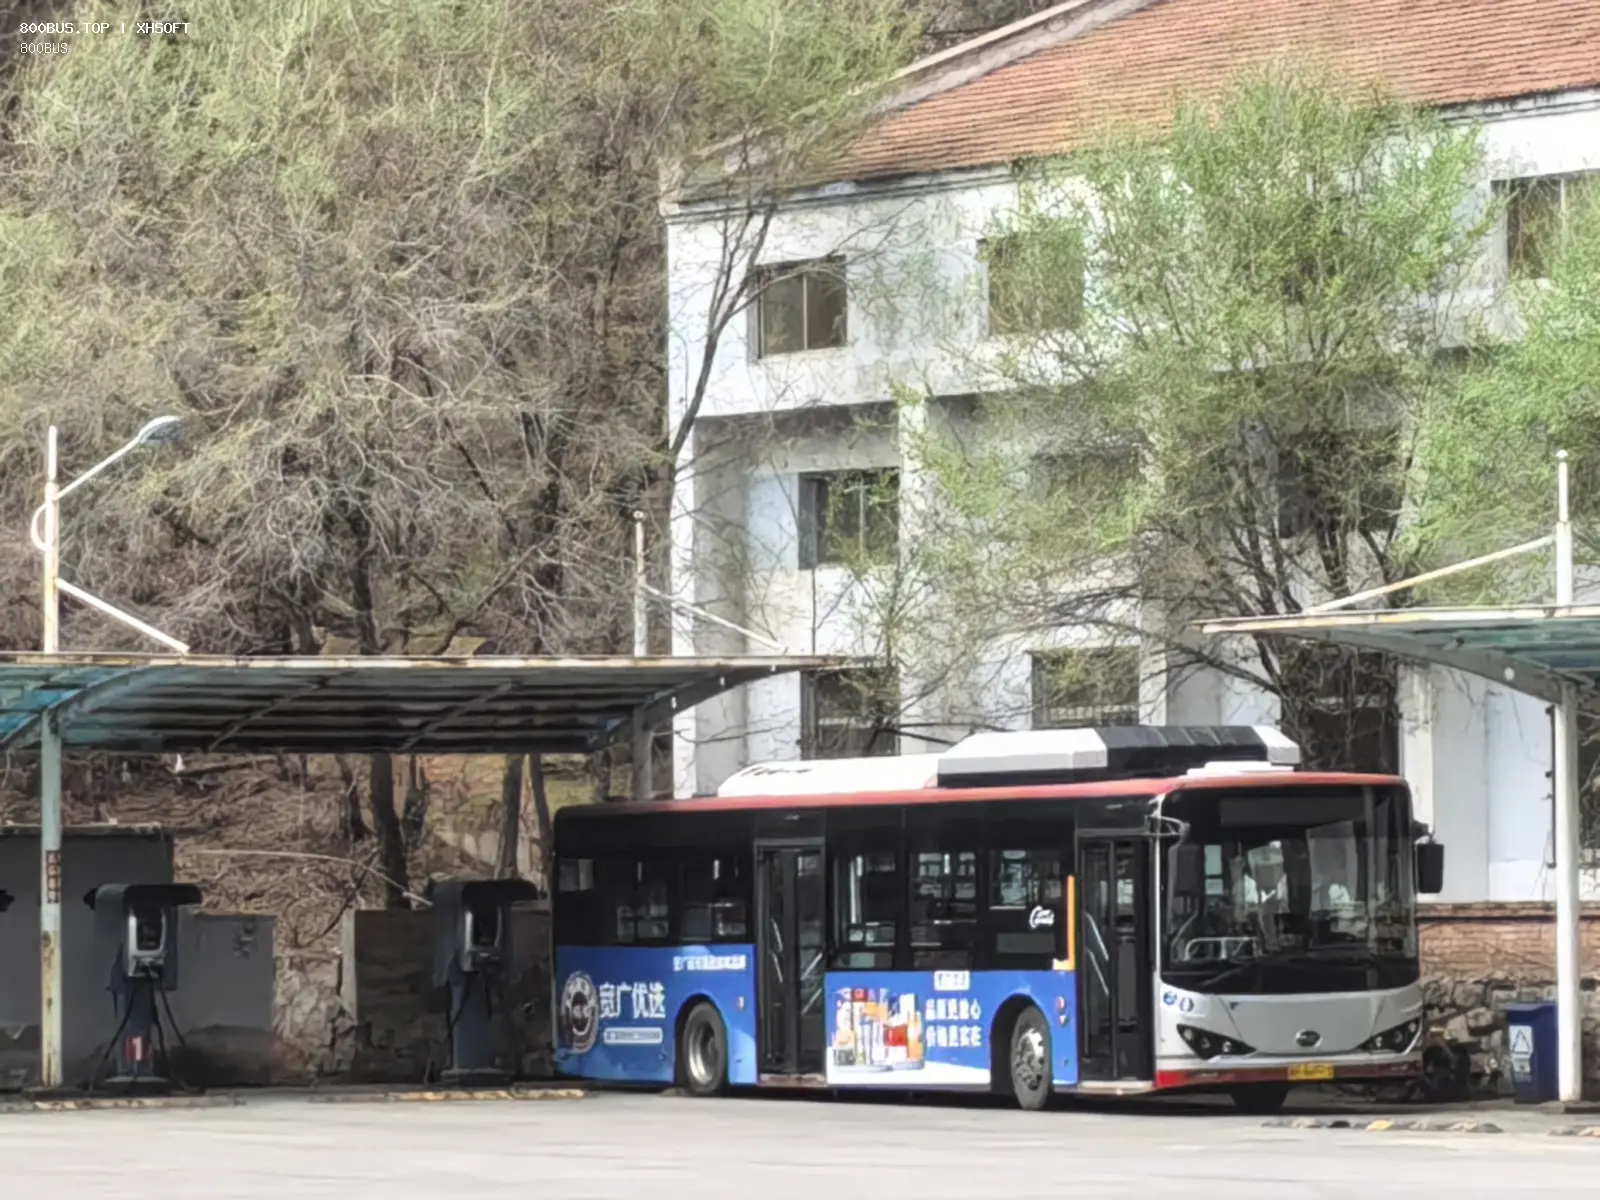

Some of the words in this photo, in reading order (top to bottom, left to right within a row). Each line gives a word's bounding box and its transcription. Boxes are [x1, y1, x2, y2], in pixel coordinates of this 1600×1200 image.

[599, 981, 666, 1019] 宽广优选
[131, 1036, 143, 1061] 1
